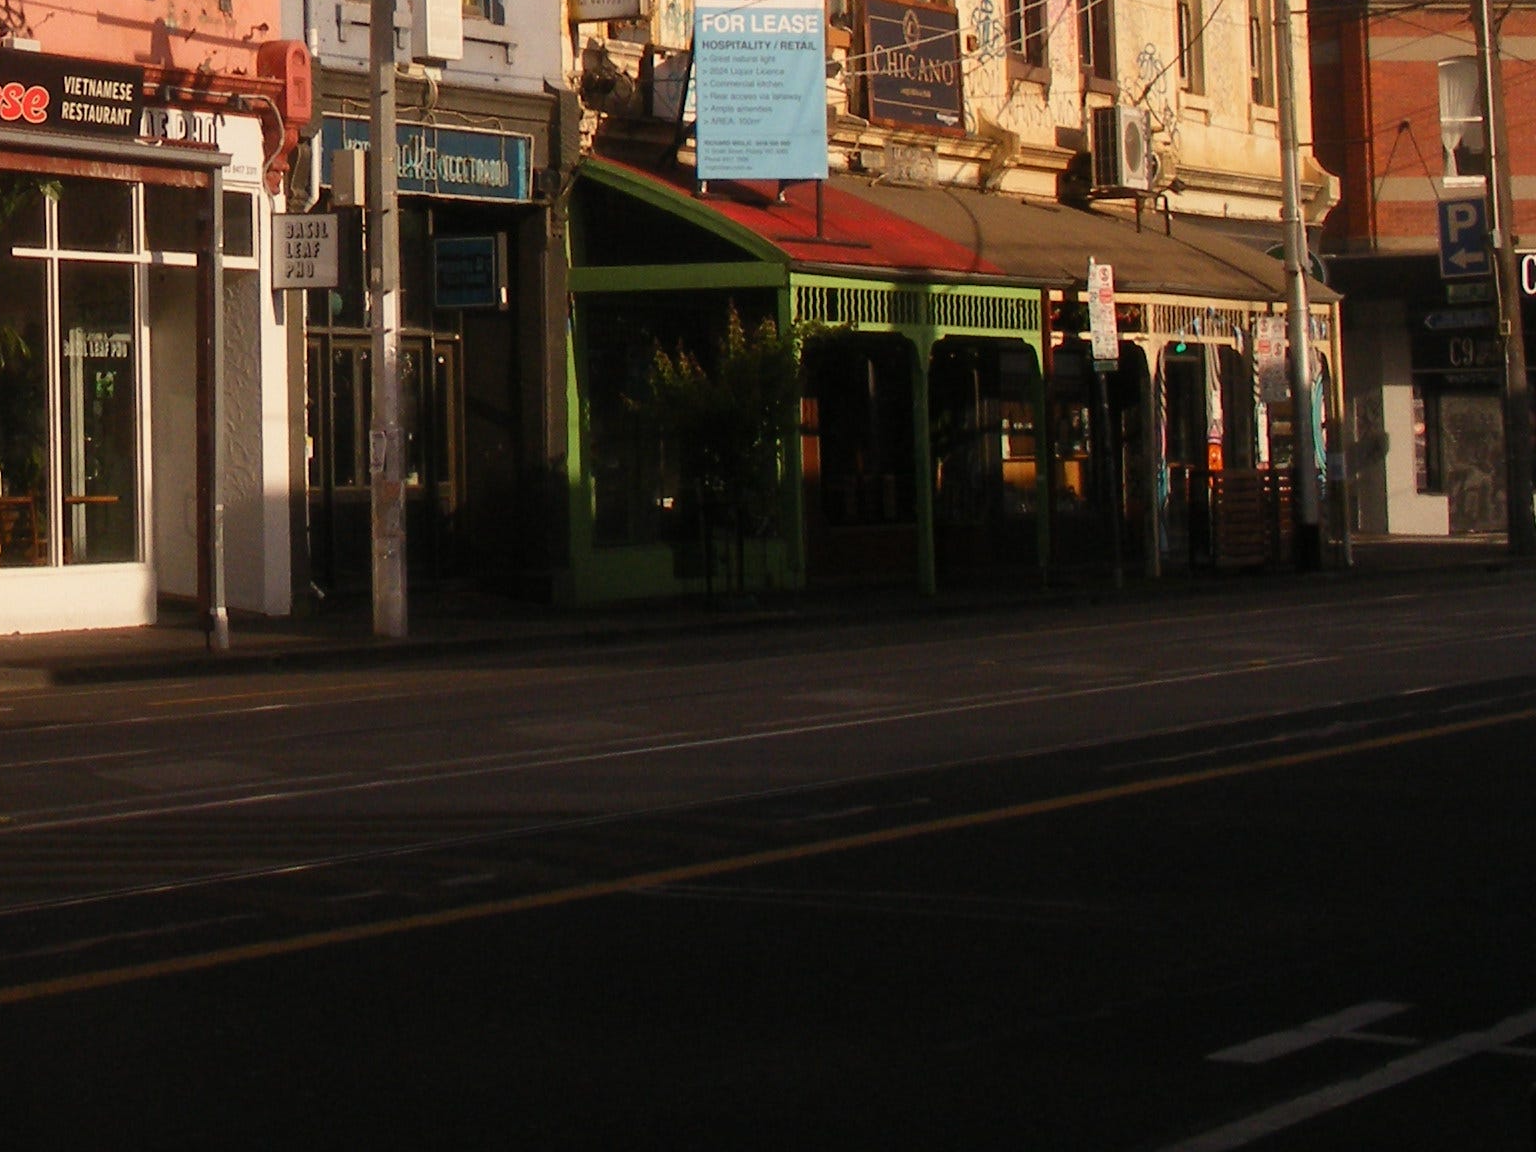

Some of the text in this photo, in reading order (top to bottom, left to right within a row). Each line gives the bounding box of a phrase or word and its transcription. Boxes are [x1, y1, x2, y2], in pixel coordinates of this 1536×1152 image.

[702, 14, 818, 33] FOR LEASE
[702, 40, 771, 50] HOSPITALITY
[780, 40, 816, 50] RETAIL
[873, 44, 953, 86] CHICANO
[64, 76, 133, 101] VIETNAMESE
[62, 101, 132, 127] RESTAURANT
[285, 221, 329, 239] BASIL
[1447, 202, 1478, 243] P
[286, 242, 321, 259] LEAF
[285, 261, 315, 279] PHO
[1449, 336, 1474, 367] C9
